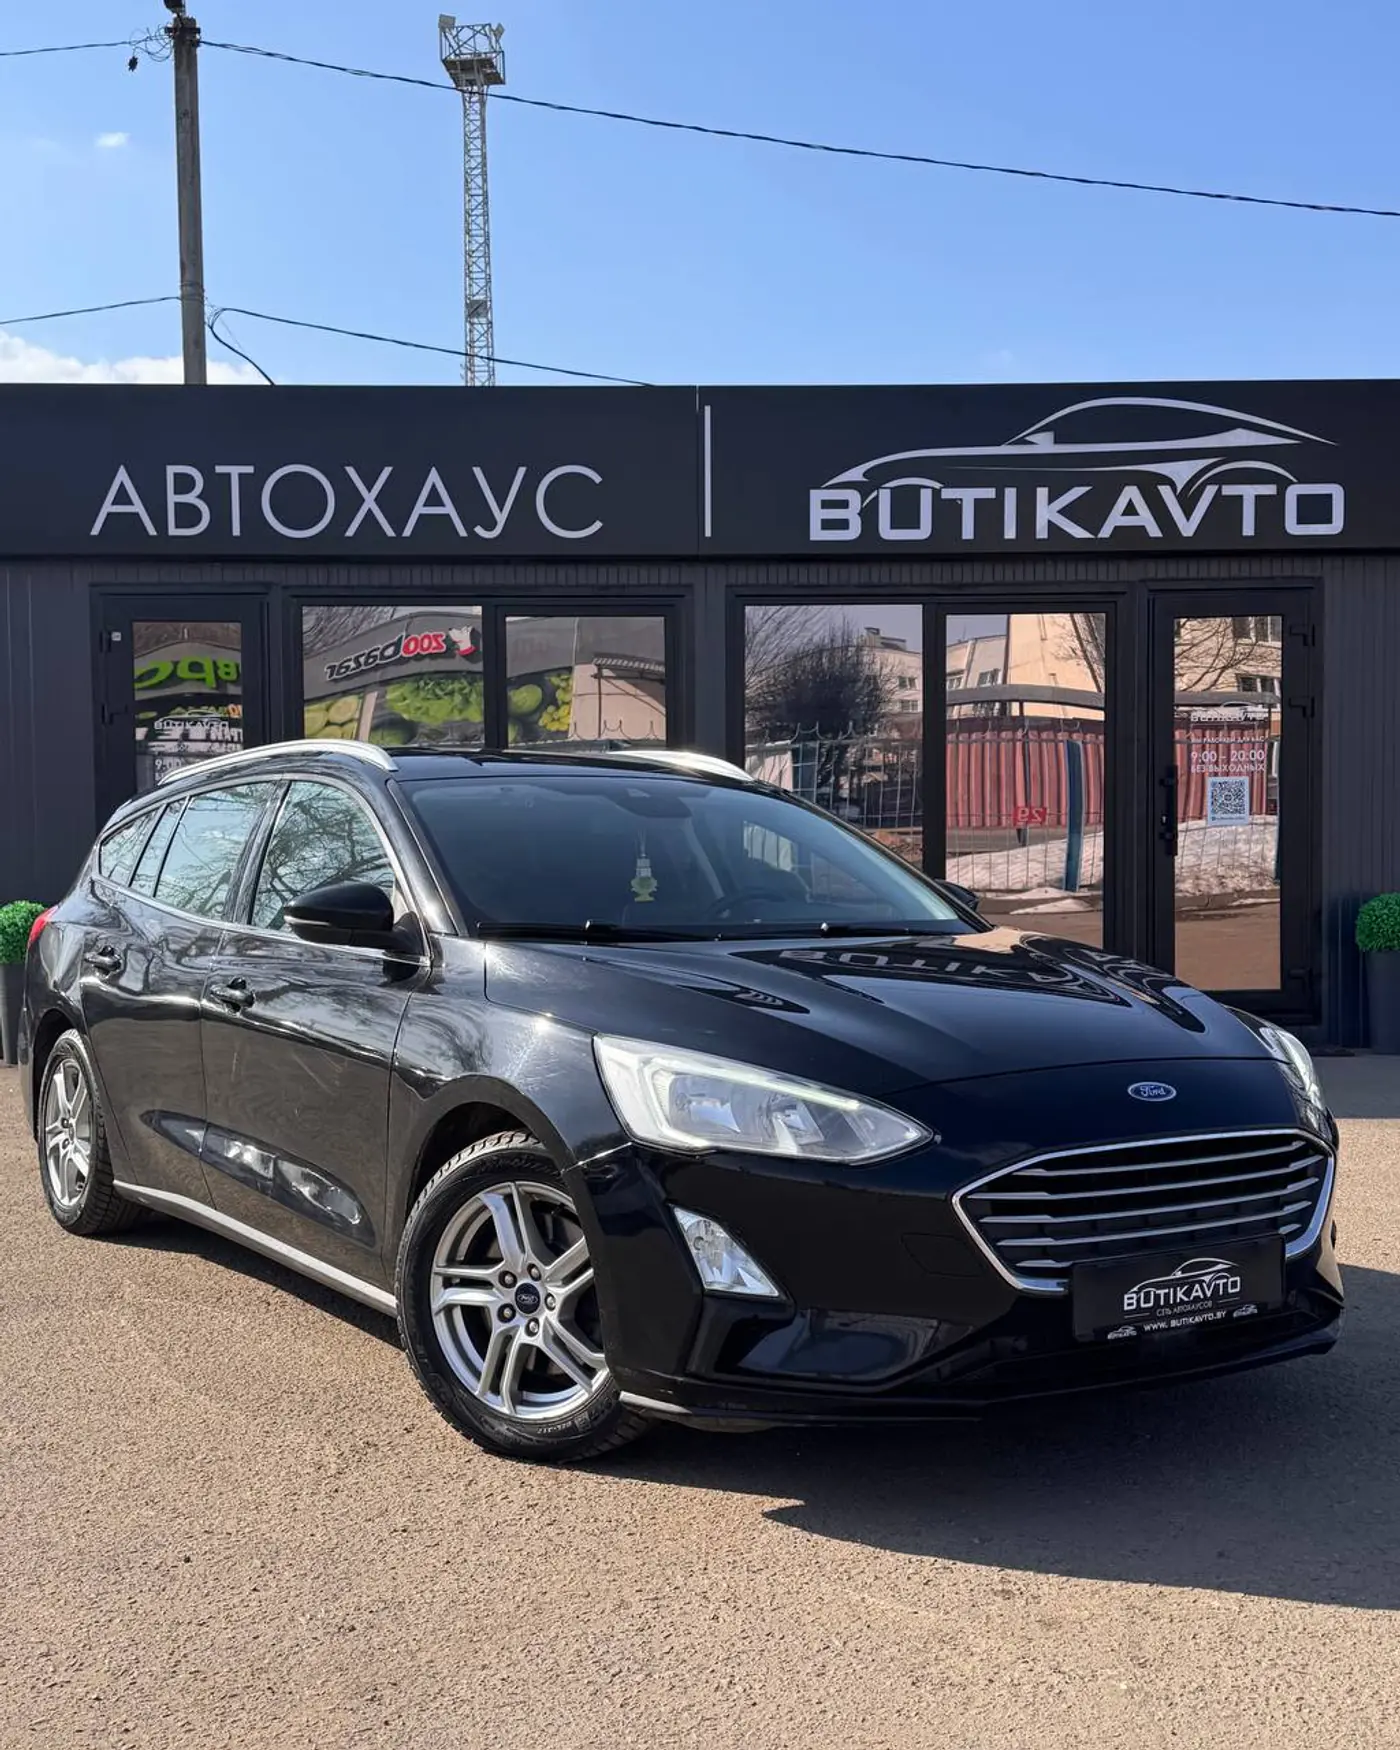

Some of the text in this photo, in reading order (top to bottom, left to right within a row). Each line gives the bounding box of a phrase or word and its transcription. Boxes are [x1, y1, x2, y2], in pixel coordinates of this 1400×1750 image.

[90, 463, 604, 539] АВТОХАУС
[809, 482, 1345, 542] BUTIKAVTO
[1191, 750, 1217, 762] 9:00
[1230, 749, 1265, 762] 20:00
[1123, 1276, 1241, 1311] BUTIKAVTO
